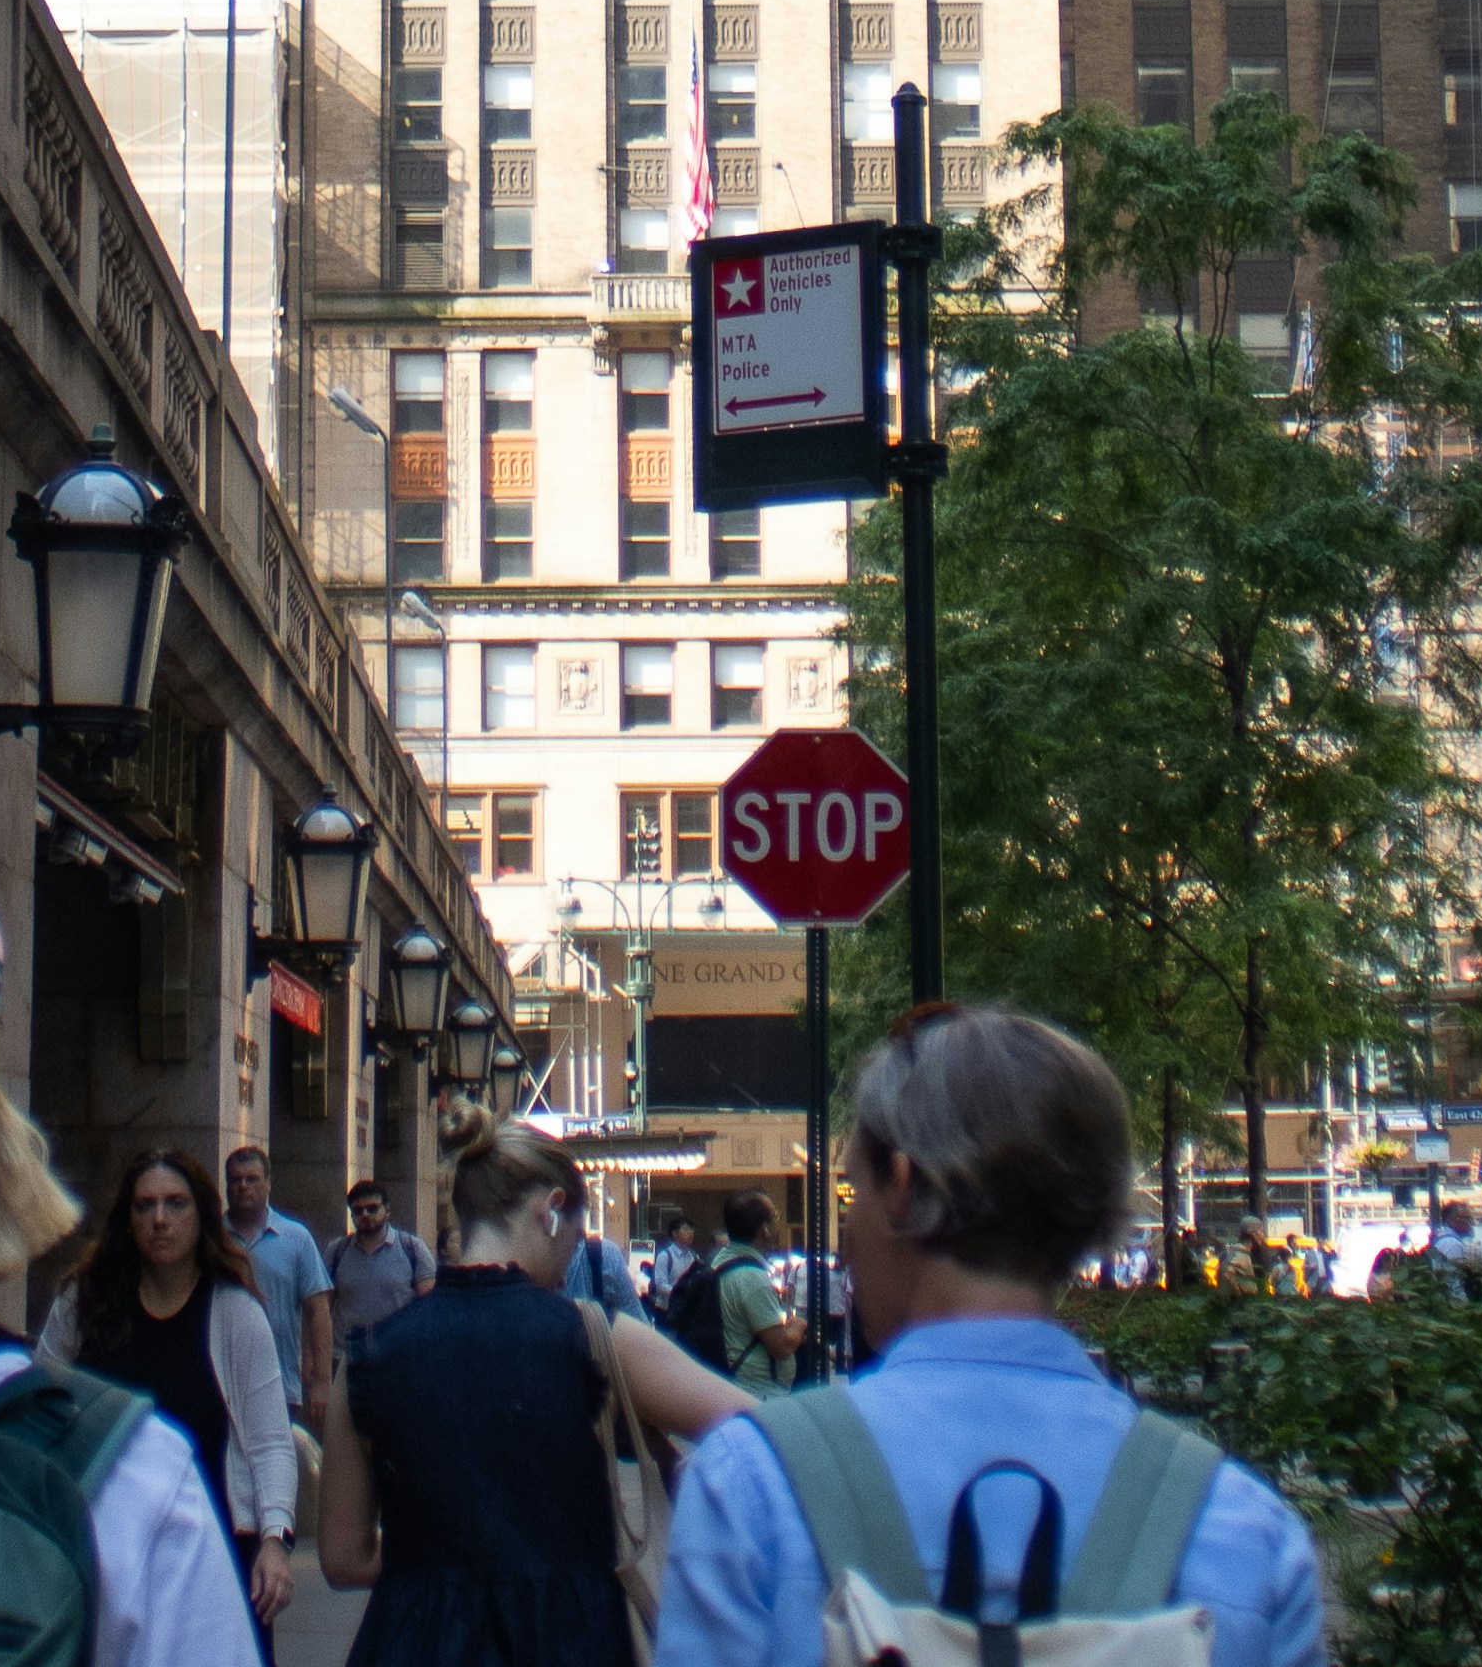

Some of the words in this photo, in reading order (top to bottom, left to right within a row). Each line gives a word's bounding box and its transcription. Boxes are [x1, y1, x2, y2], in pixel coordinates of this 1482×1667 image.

[770, 248, 851, 274] Authorized
[770, 273, 831, 293] Vehicles
[770, 295, 802, 314] Only
[722, 334, 757, 354] MTA
[722, 361, 770, 382] Police
[732, 791, 903, 863] STOP
[653, 962, 686, 983] NE
[694, 962, 786, 983] GRAND
[1446, 1110, 1468, 1120] East
